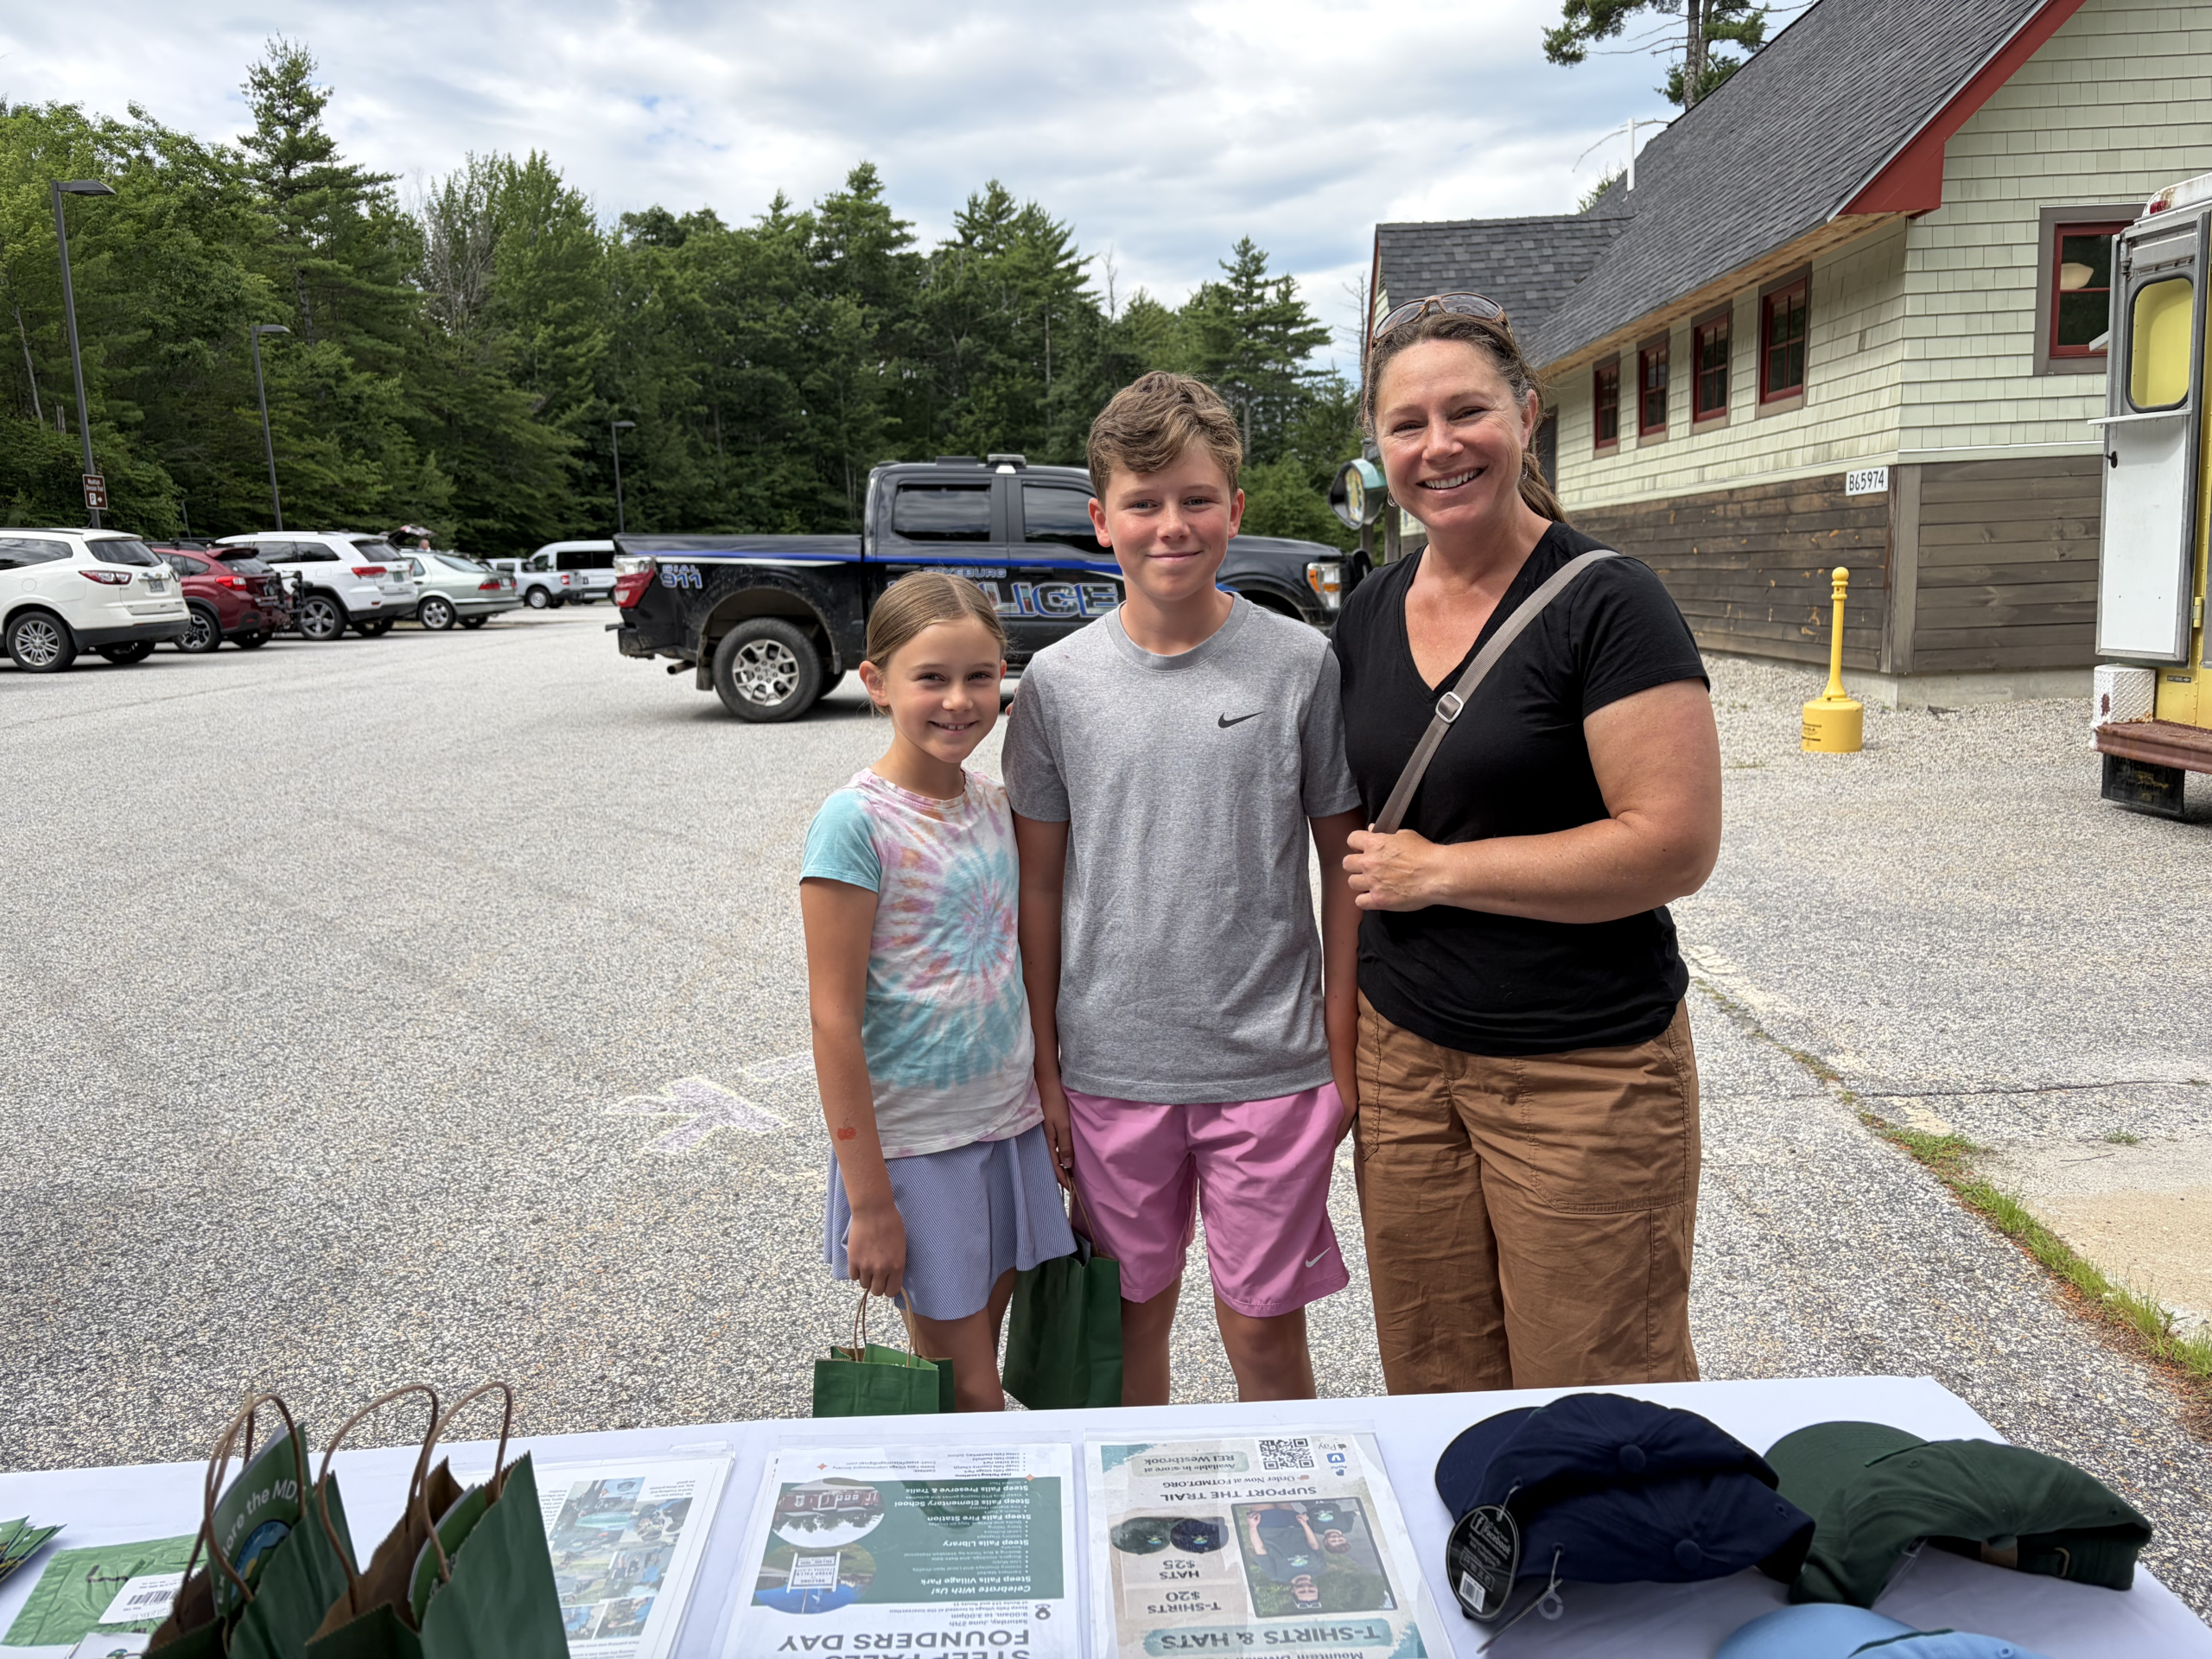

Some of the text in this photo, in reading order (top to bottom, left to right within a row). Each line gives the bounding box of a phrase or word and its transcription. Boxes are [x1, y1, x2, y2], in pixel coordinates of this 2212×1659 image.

[1849, 469, 1885, 492] B65974
[91, 494, 95, 503] P
[663, 564, 700, 573] DIAL
[660, 572, 703, 589] 911
[980, 582, 1119, 618] LICE
[1144, 1456, 1210, 1465] Westbrook
[1162, 1479, 1230, 1488] FOTMDT.ORG
[246, 1486, 270, 1516] the
[1160, 1487, 1317, 1502] SUPPORT THE TRAIL
[1483, 1525, 1512, 1555] Facebook
[1163, 1560, 1195, 1569] $25
[1160, 1570, 1199, 1580] HATS
[1166, 1591, 1200, 1602] $20
[1147, 1602, 1221, 1614] T-SHIRTS
[776, 1630, 1028, 1651] FOUNDERS DAY
[1161, 1626, 1381, 1649] T-SHIRTS & HATS
